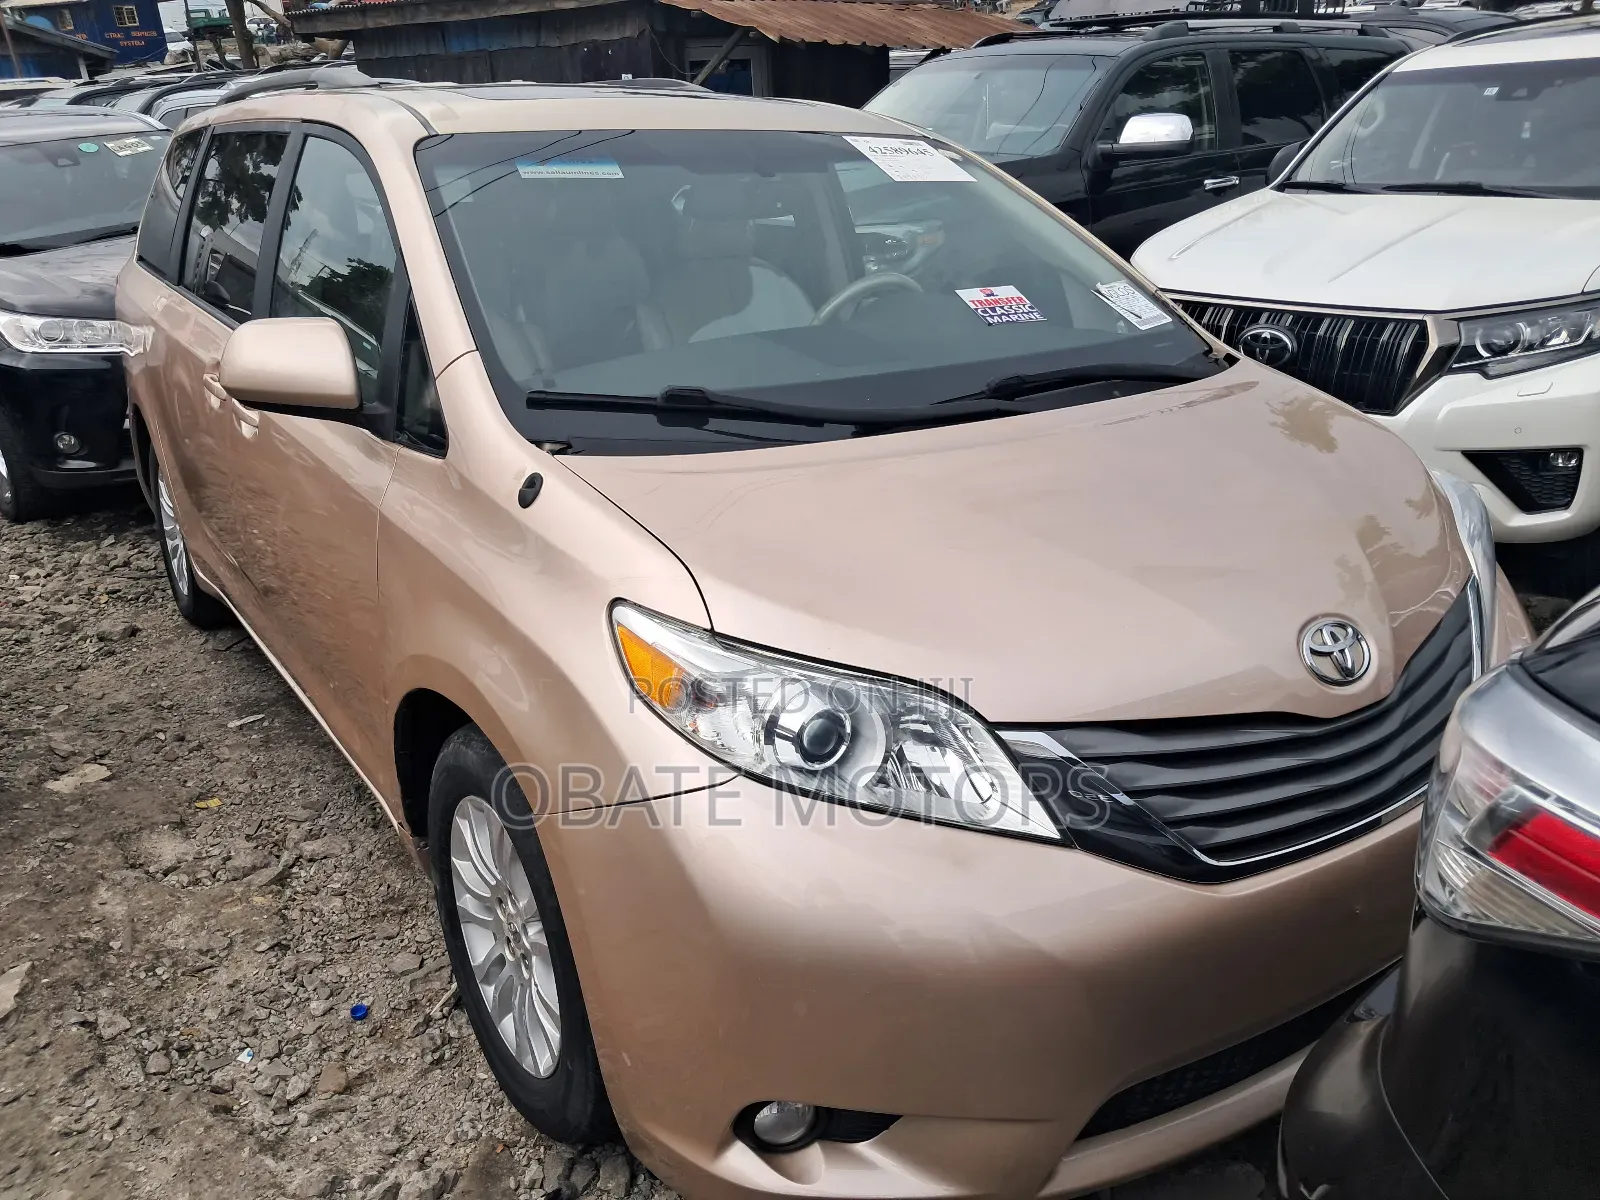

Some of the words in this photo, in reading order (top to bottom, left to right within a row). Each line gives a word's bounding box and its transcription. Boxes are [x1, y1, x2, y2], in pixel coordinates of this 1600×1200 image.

[868, 145, 935, 157] 42589645
[968, 296, 1028, 308] TRANSFER
[977, 304, 1037, 317] CLASSIC
[985, 312, 1045, 324] MARINE
